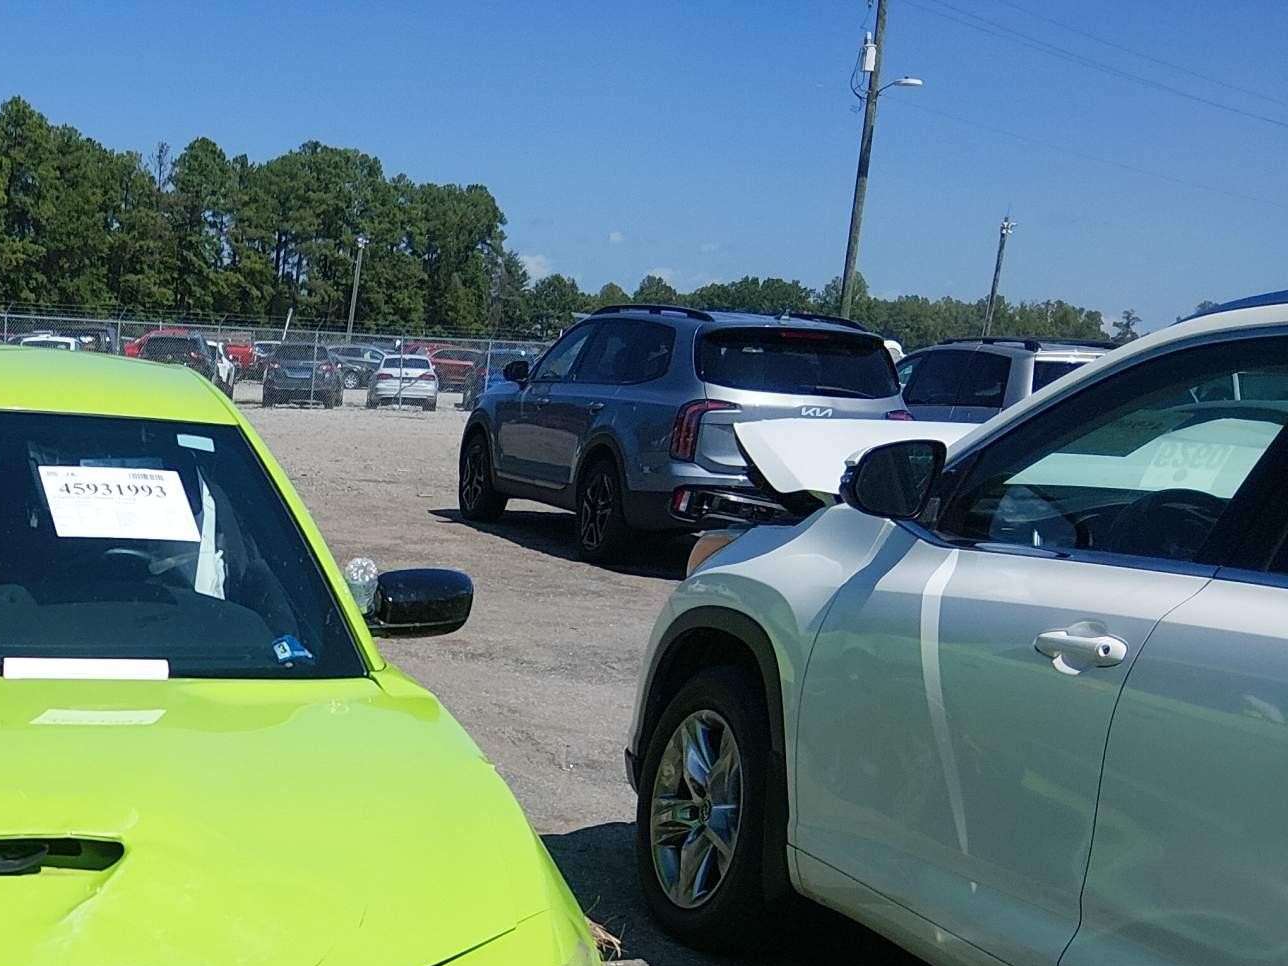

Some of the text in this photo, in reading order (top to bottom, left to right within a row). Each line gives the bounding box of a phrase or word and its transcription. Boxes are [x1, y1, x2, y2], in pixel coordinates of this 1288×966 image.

[801, 406, 833, 417] KIA
[59, 482, 167, 498] 45931993
[278, 643, 287, 653] 3
